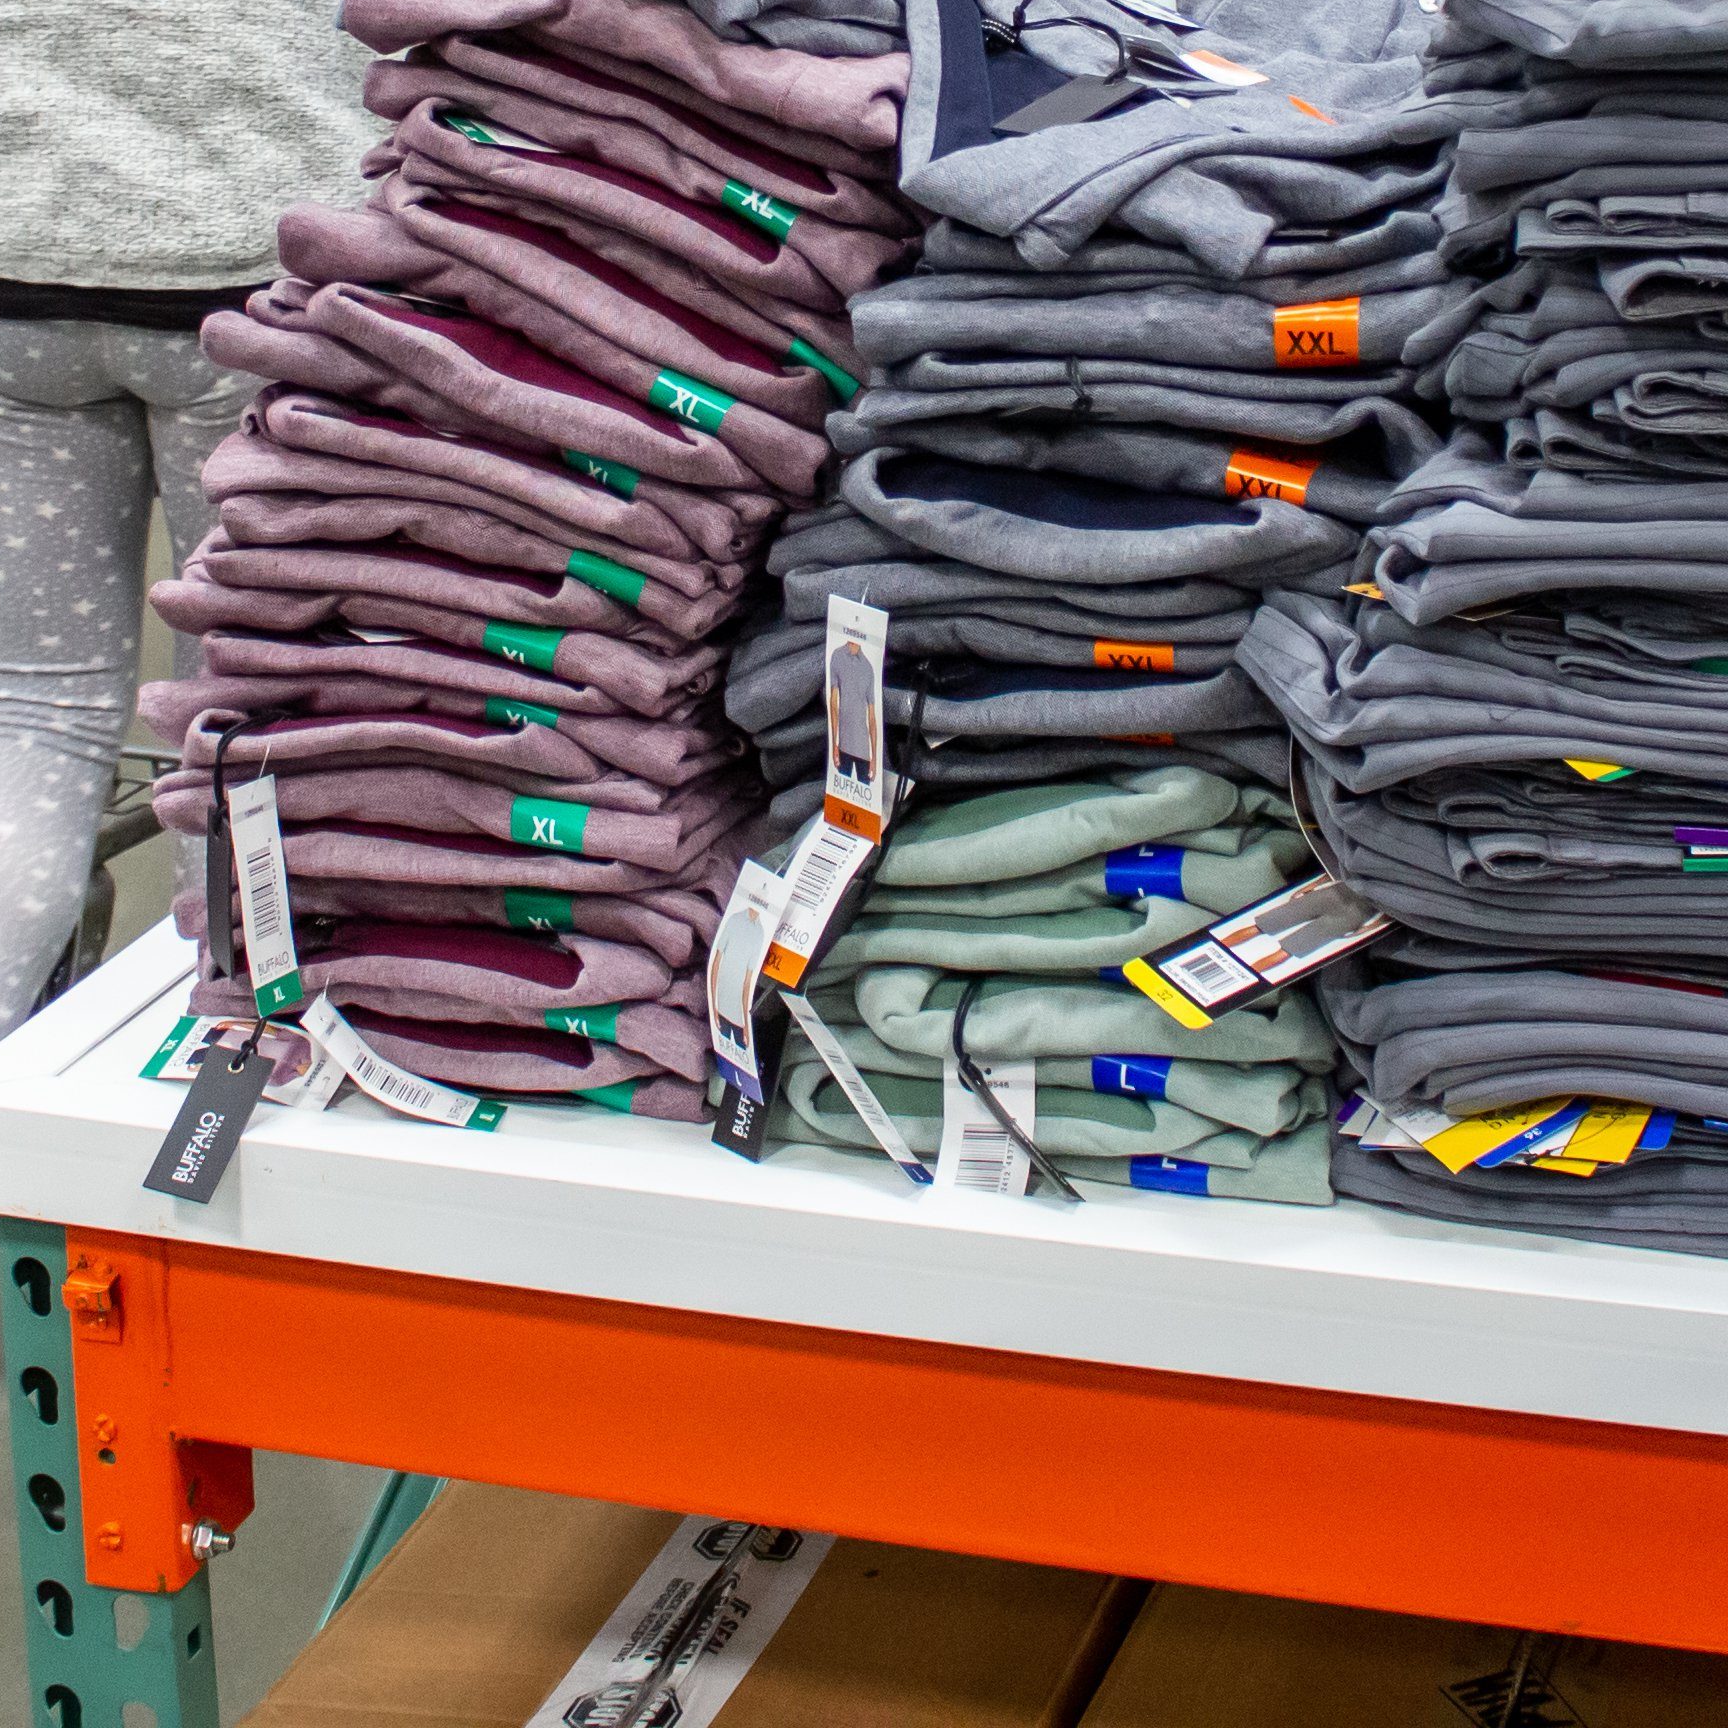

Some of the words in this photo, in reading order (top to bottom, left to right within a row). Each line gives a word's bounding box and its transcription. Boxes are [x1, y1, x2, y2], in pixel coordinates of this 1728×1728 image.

[1286, 329, 1346, 356] XXL
[668, 385, 700, 424] XL
[832, 773, 874, 802] BUFFALO
[531, 814, 565, 847] XL
[256, 950, 291, 977] BUFFALO
[1121, 1063, 1136, 1092] L
[731, 1093, 753, 1139] BUFF
[171, 1111, 218, 1183] BUFFALO
